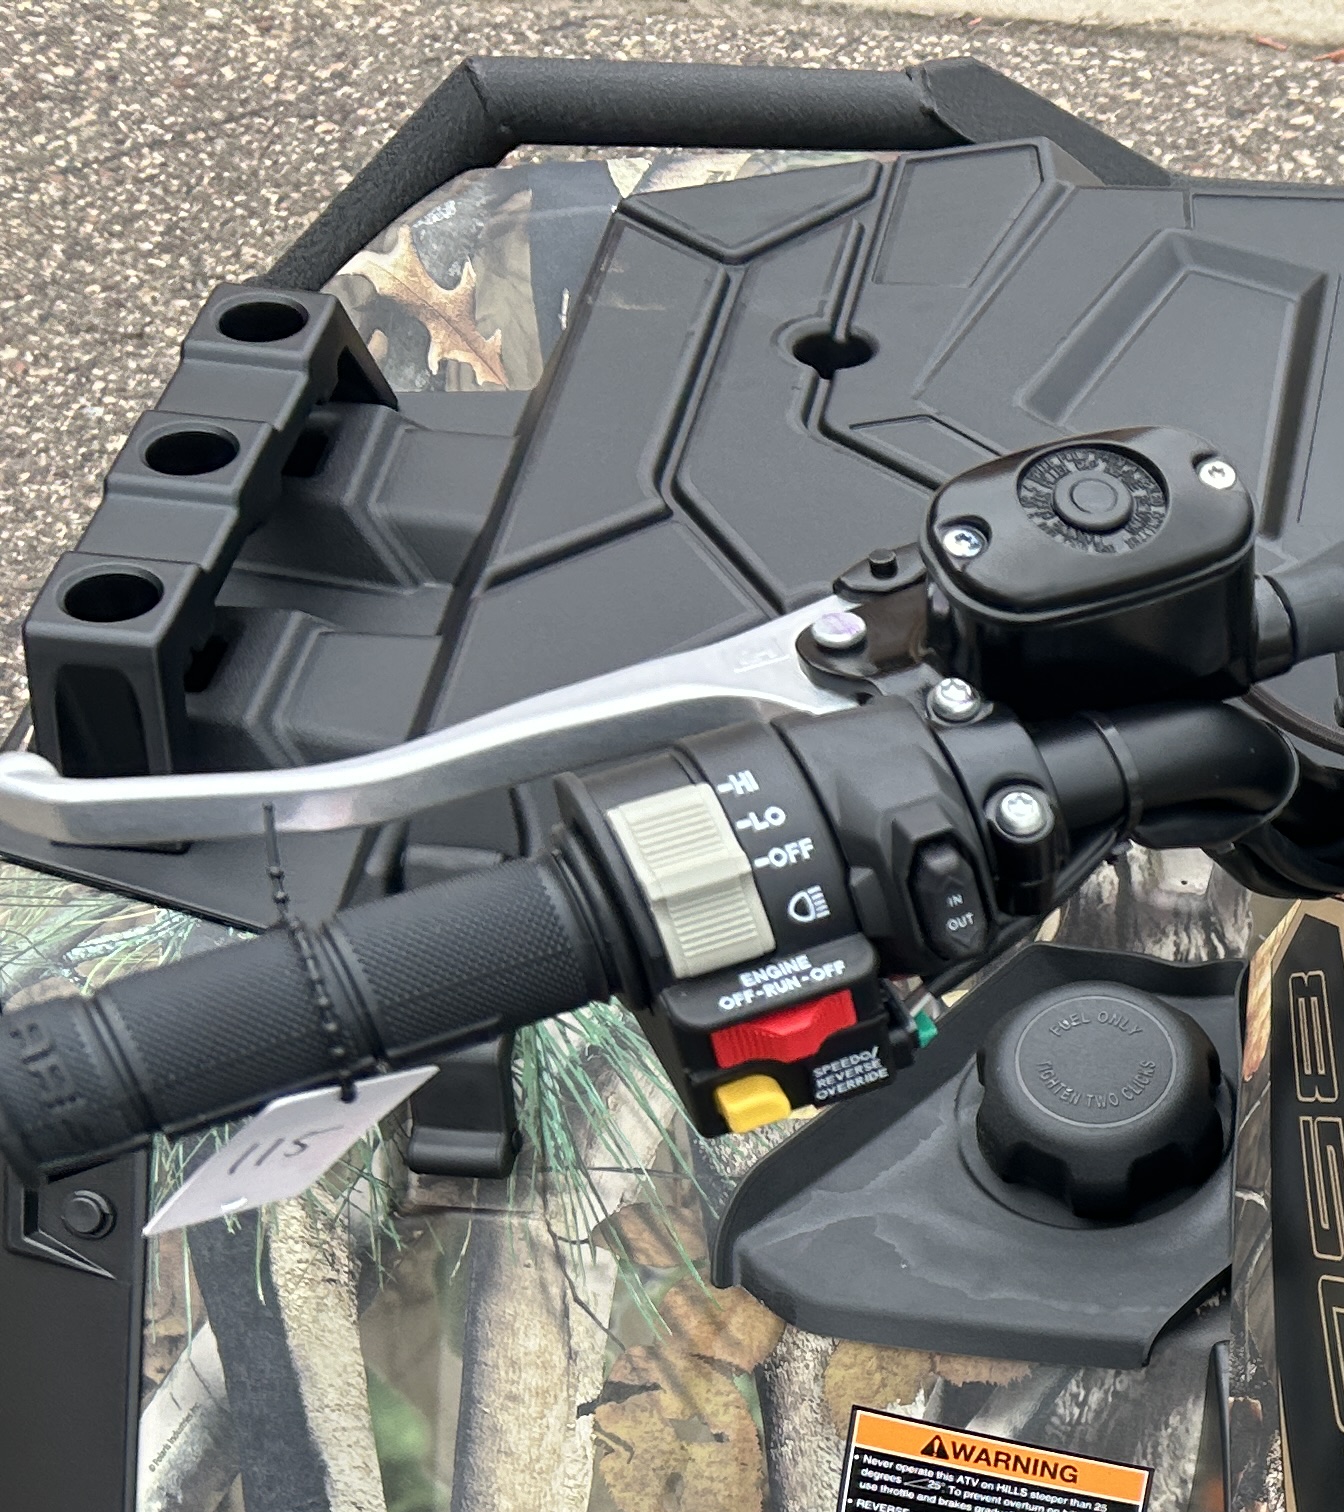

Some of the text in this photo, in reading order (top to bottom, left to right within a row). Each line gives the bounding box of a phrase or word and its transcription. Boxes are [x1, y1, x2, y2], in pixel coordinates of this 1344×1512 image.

[947, 894, 963, 908] IN
[947, 913, 976, 931] OUT
[739, 955, 812, 988] ENGINE
[1049, 1010, 1144, 1038] FUEL ONLY
[816, 1059, 883, 1090] REVERSE
[816, 1069, 889, 1101] OVERRIDE
[1086, 1093, 1120, 1110] TWO
[1122, 1059, 1157, 1101] CLICKS
[949, 1441, 1078, 1483] WARNING
[858, 1481, 878, 1491] use
[879, 1484, 915, 1499] throttle
[916, 1492, 937, 1503] and
[937, 1497, 972, 1511] brakes
[860, 1467, 902, 1485] degrees
[947, 1484, 962, 1497] To
[962, 1489, 1002, 1505] prevent
[1002, 1497, 1045, 1512] overturn
[862, 1454, 1108, 1512] Never operate this ATV on HILLS steeper than 25
